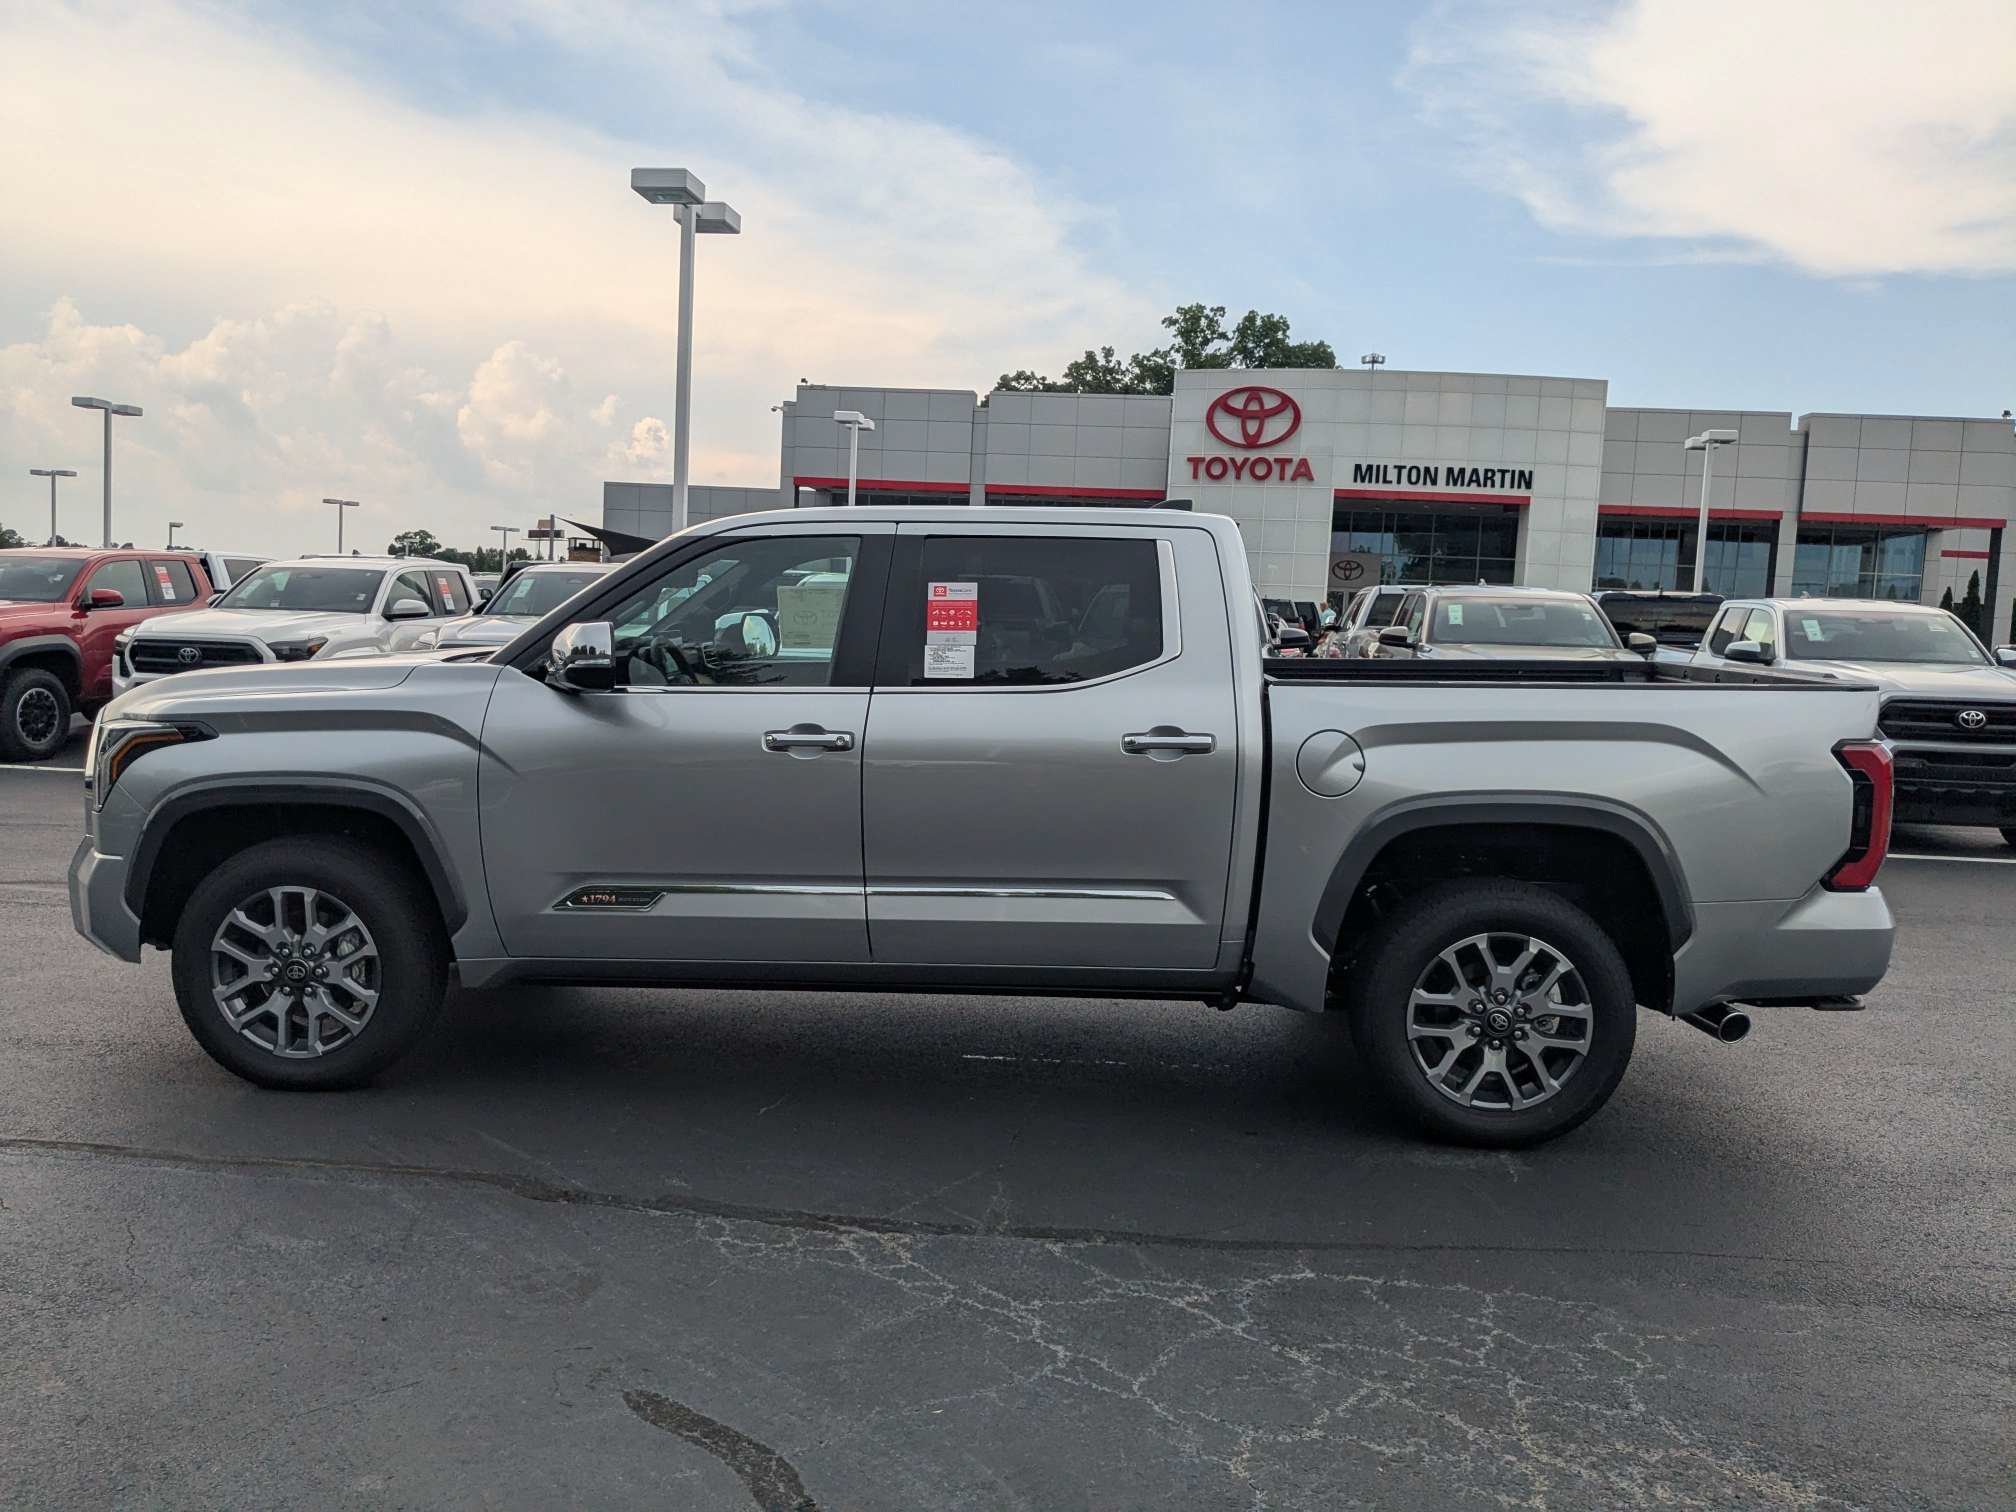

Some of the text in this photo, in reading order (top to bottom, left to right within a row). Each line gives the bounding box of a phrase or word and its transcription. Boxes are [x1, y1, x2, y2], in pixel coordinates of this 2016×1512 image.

[1187, 456, 1314, 481] TOYOTA
[1353, 463, 1533, 490] MILTON MARTIN
[590, 895, 616, 904] 1794
